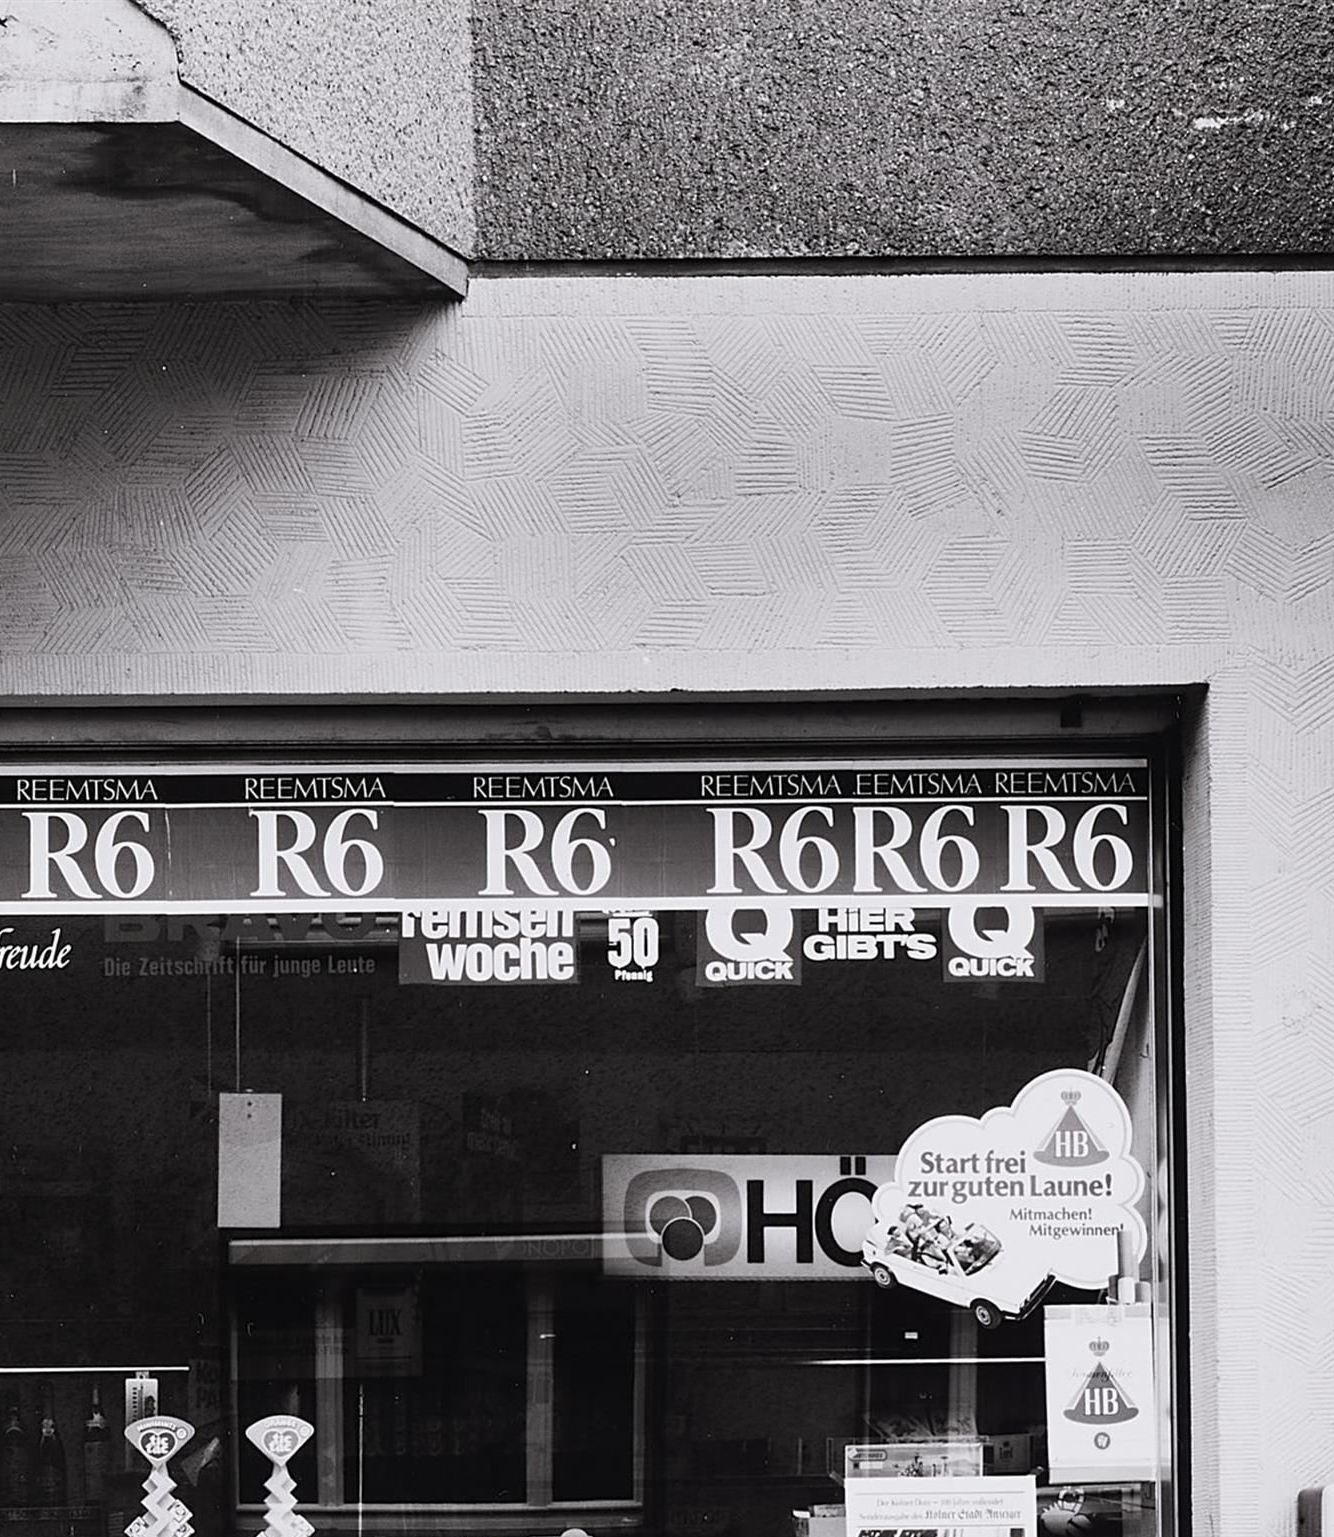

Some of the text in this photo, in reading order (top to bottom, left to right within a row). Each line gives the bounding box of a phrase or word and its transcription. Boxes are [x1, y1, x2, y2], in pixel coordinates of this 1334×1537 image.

[16, 779, 158, 801] REEMTSMA
[244, 777, 386, 799] REEMTSMA
[472, 776, 614, 799] REEMTSMA
[701, 774, 842, 797] REEMTSMA
[853, 772, 983, 796] EEMTSMA
[994, 771, 1136, 794] REEMTSMA
[21, 811, 155, 899] R6
[248, 809, 384, 898] R6
[477, 807, 612, 896] R6
[705, 806, 840, 894] R6
[853, 804, 980, 894] R6
[999, 804, 1133, 893] R6
[607, 917, 659, 969] 50
[705, 907, 794, 962] Q
[948, 906, 1035, 961] Q
[426, 938, 574, 982] woche
[803, 934, 937, 961] GIBT'S
[104, 955, 375, 978] Die Zeitschrift für junge Leute
[615, 970, 653, 983] Pfennig
[705, 960, 794, 982] QUICK
[948, 957, 1035, 977] QUICK
[1056, 1131, 1089, 1158] HB
[920, 1151, 1026, 1174] Start frei
[908, 1174, 1112, 1204] zur guten Laune!
[1010, 1207, 1092, 1221] Mitmachen!
[1084, 1387, 1119, 1416] HB
